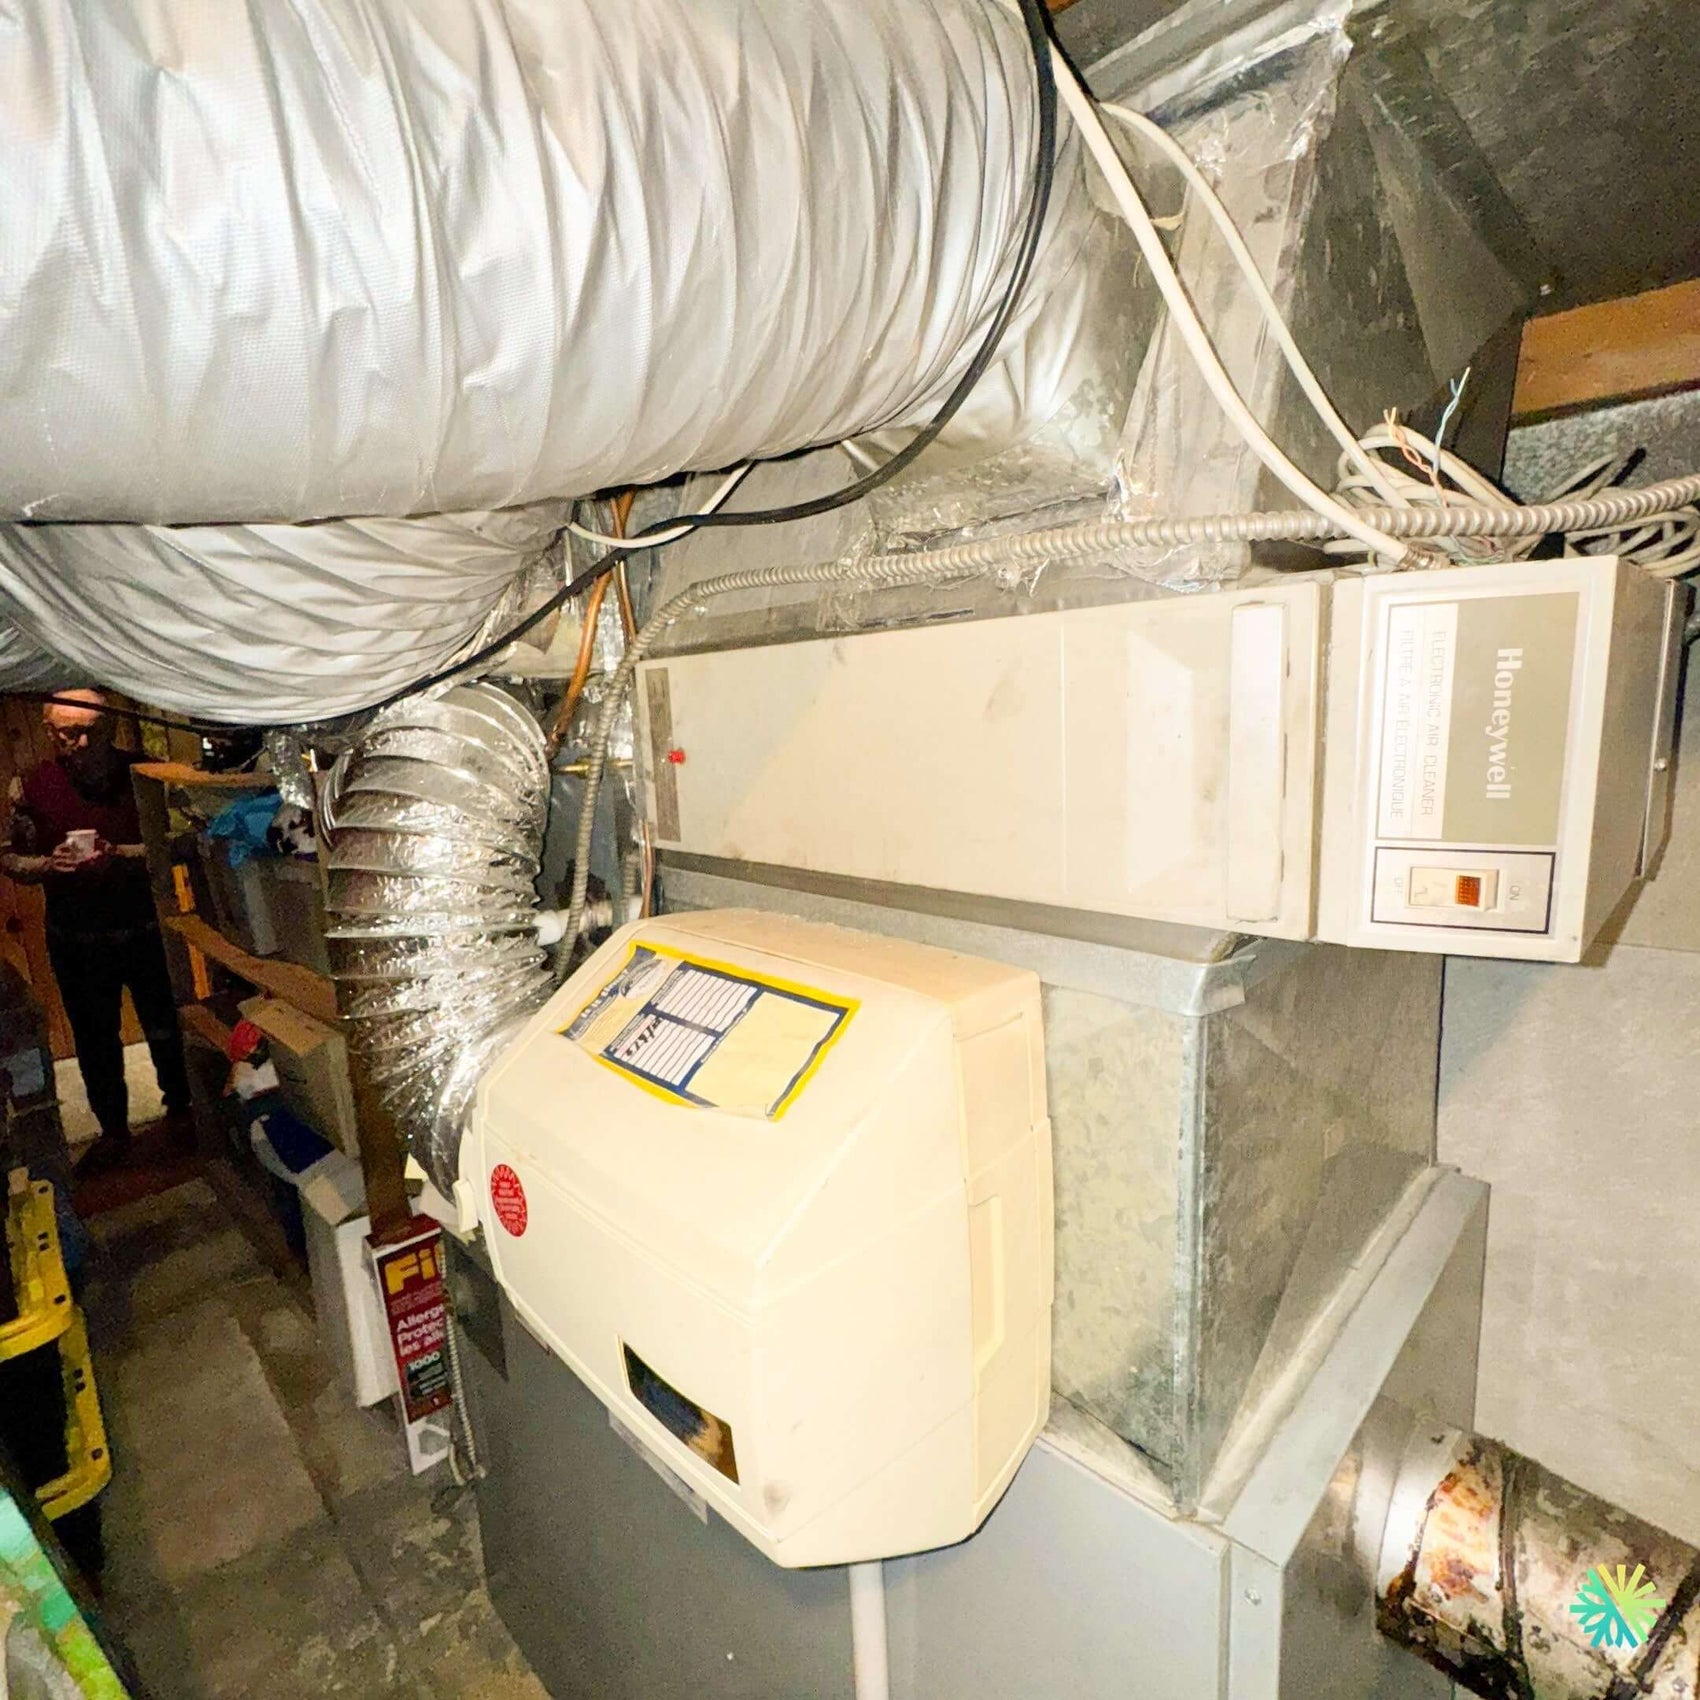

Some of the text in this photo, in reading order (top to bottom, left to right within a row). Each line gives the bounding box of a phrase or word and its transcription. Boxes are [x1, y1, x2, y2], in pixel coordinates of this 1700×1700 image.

[1398, 693, 1411, 715] AIR
[1420, 630, 1447, 816] ELECTRONIC AIR CLEANER
[1485, 648, 1523, 799] Honeywell
[1509, 884, 1521, 901] ON
[408, 1351, 441, 1371] 1000
